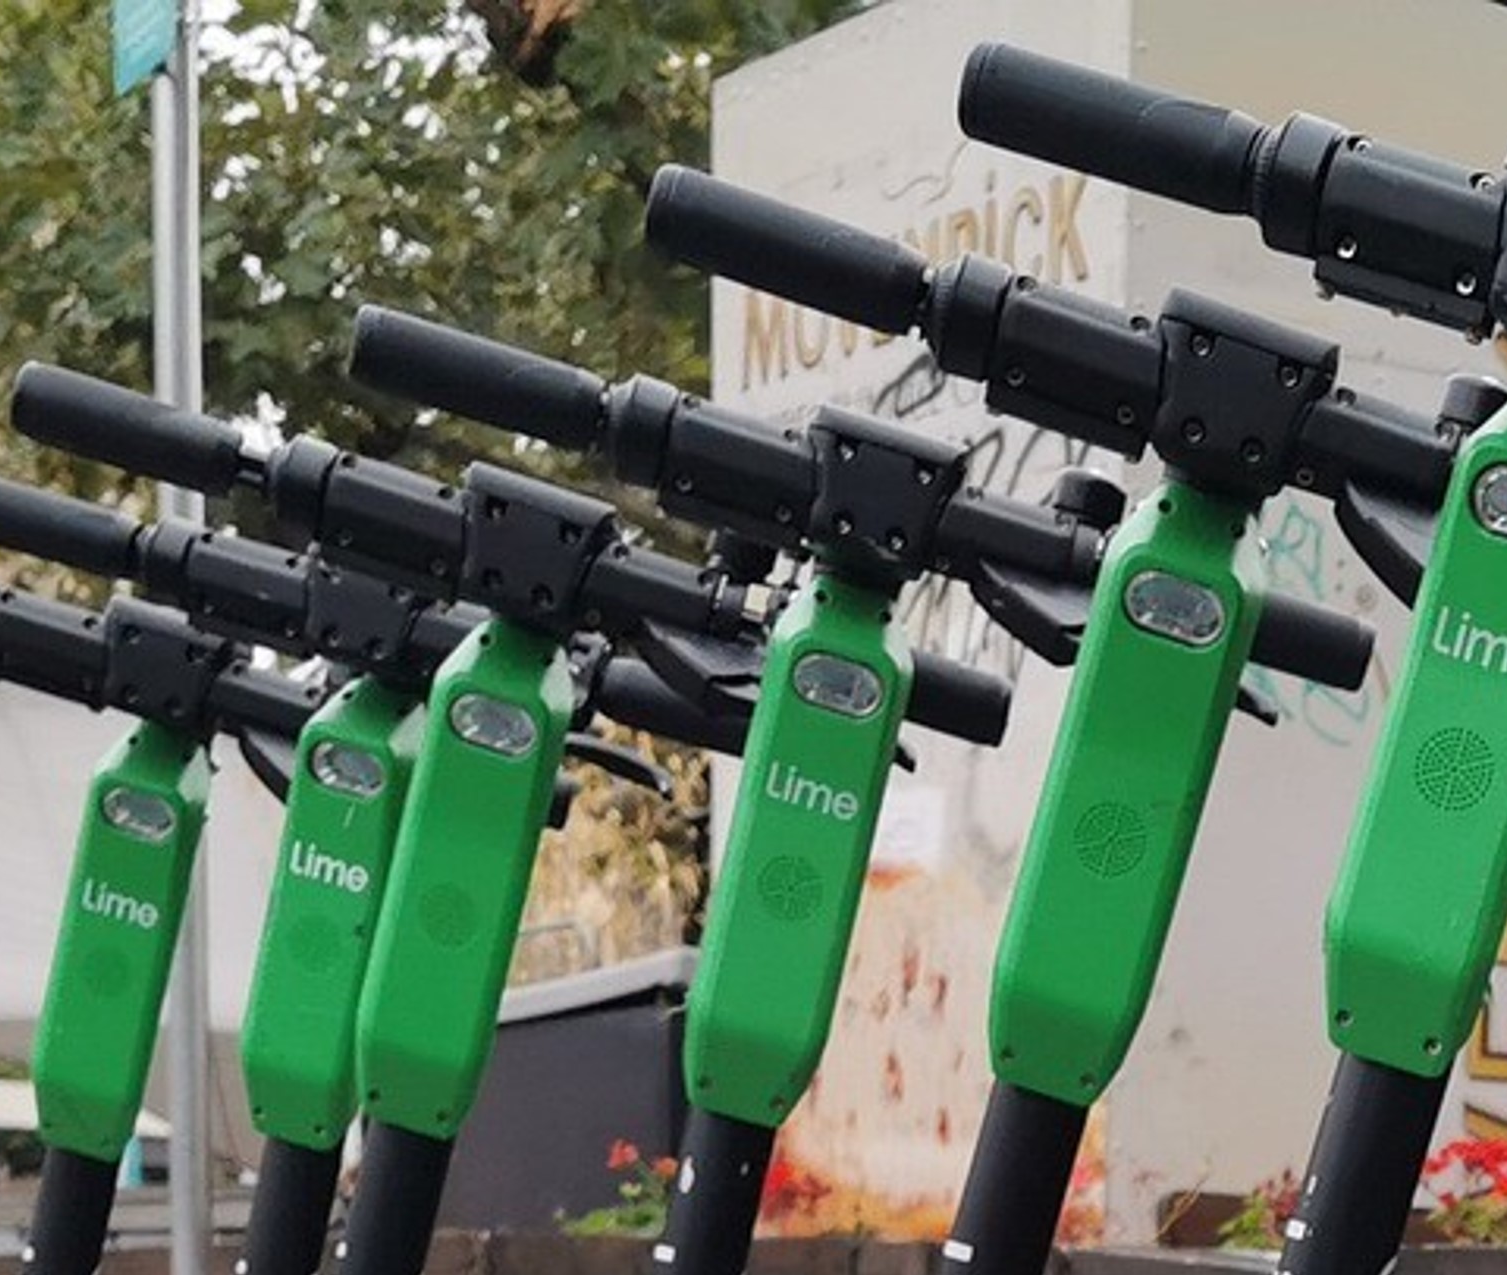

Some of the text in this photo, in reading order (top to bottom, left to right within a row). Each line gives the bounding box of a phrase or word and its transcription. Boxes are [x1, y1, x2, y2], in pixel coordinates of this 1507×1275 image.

[765, 760, 860, 821] Lime
[288, 839, 370, 893] Lime
[81, 877, 159, 930] Lime
